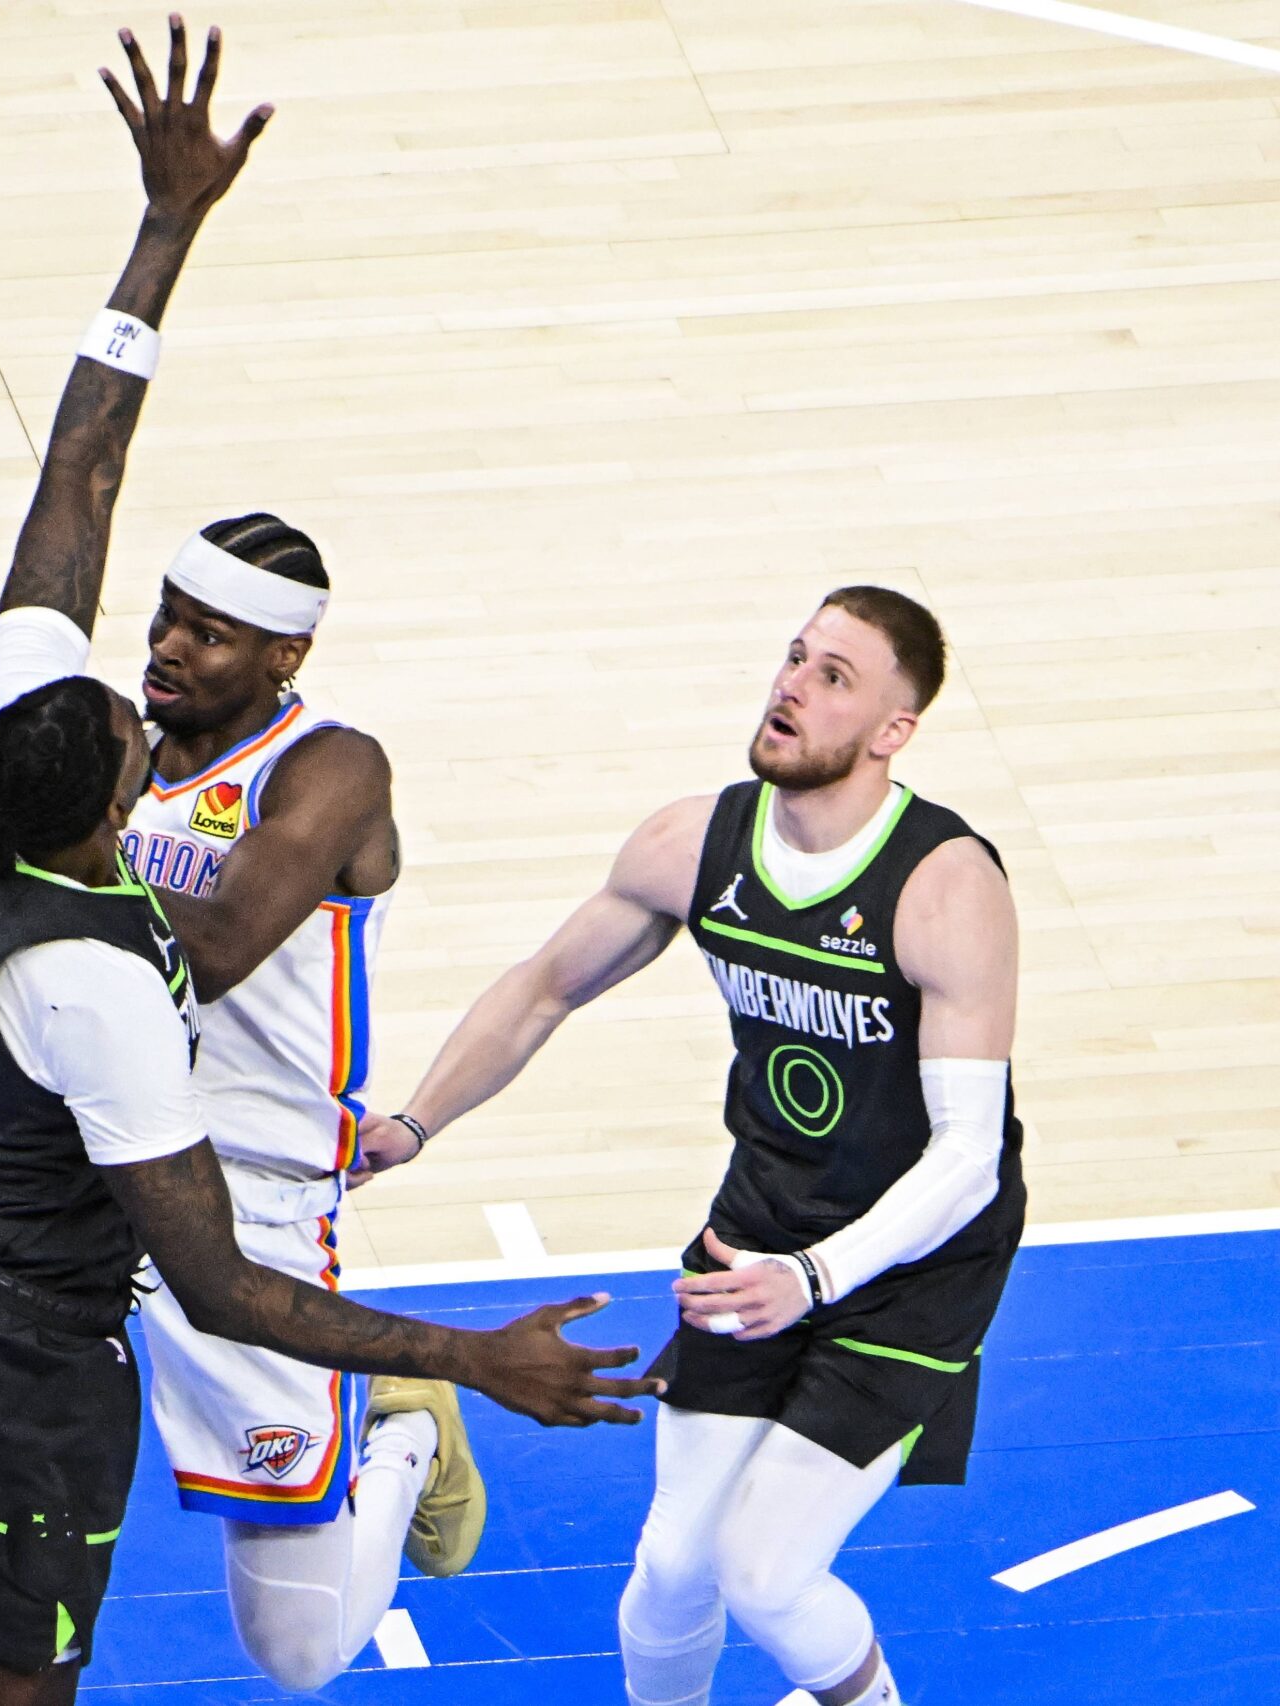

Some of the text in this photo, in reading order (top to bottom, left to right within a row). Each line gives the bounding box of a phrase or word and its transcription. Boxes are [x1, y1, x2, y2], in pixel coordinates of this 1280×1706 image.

[192, 811, 236, 834] Love's
[819, 933, 876, 956] sezzle
[767, 1044, 845, 1138] 0
[248, 1434, 297, 1466] OKC
